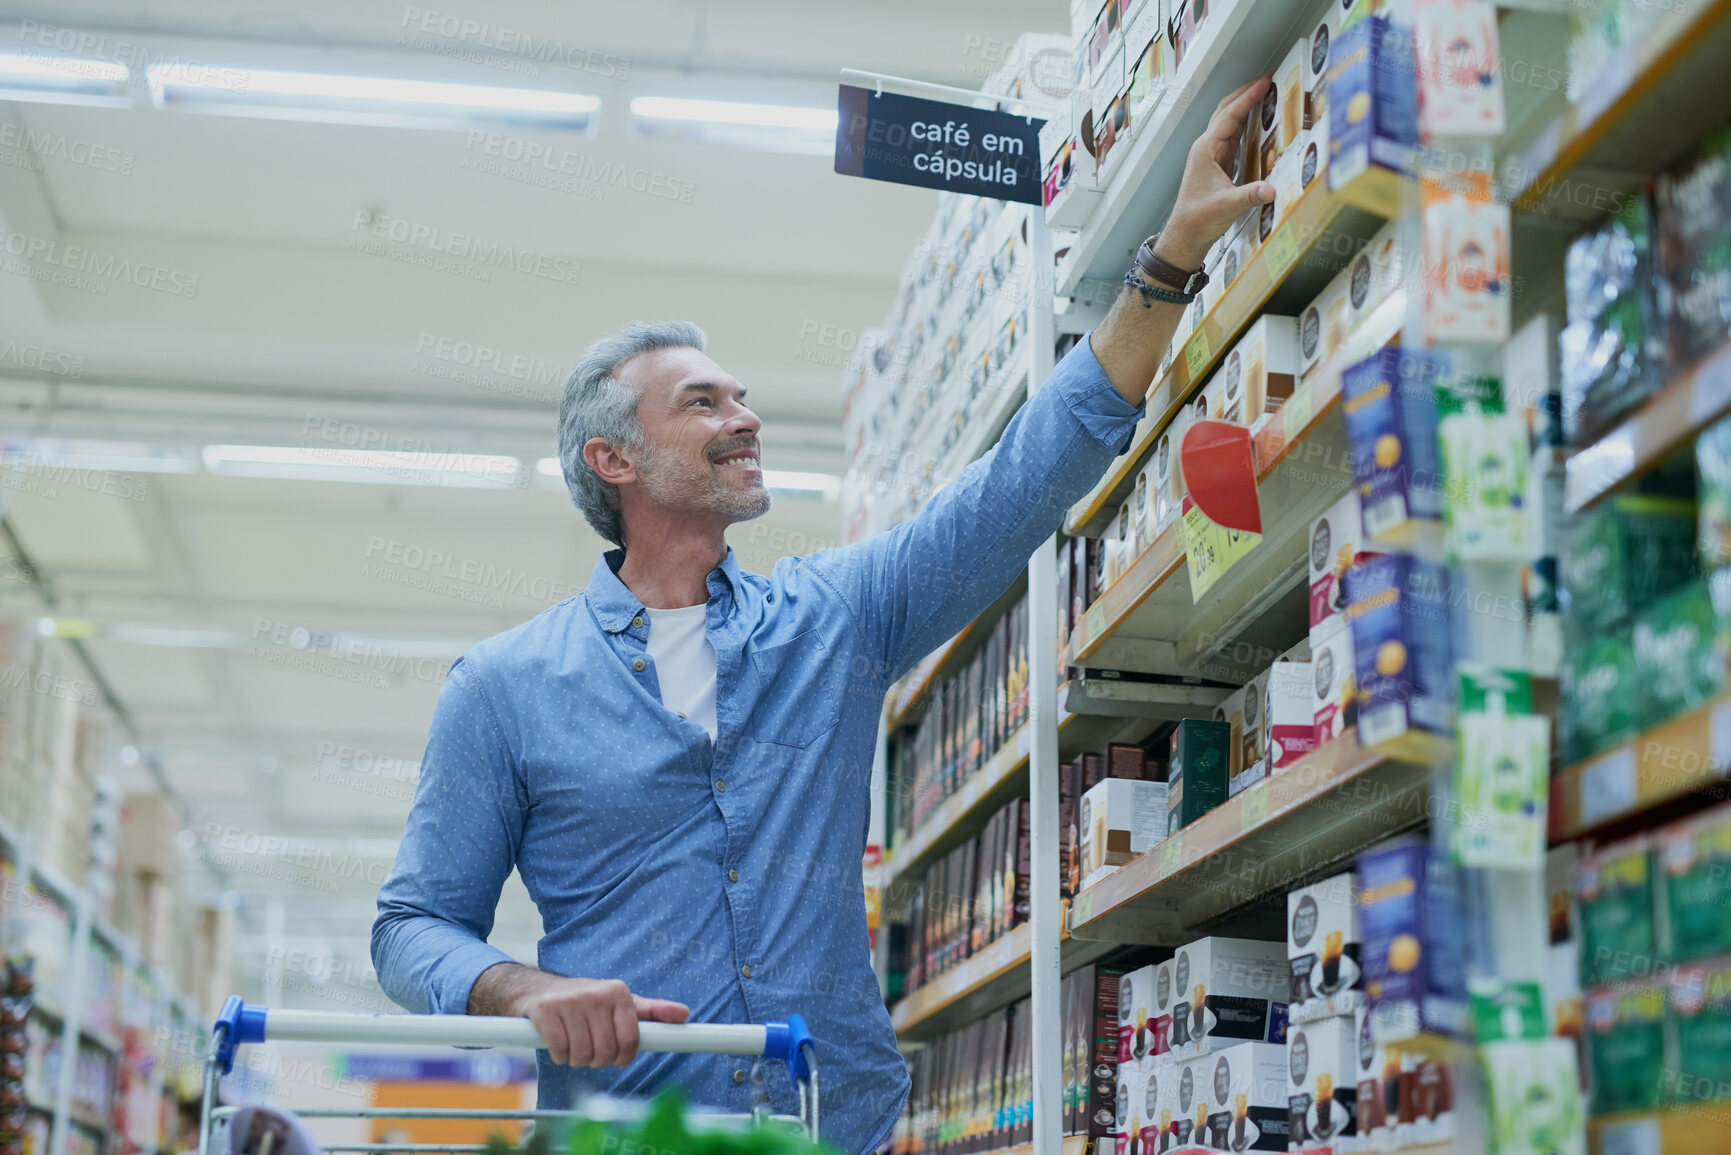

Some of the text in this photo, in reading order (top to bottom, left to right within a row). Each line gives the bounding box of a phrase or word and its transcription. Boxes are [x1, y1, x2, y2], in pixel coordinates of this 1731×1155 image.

[911, 121, 1024, 155] café em
[913, 150, 1017, 185] cápsula
